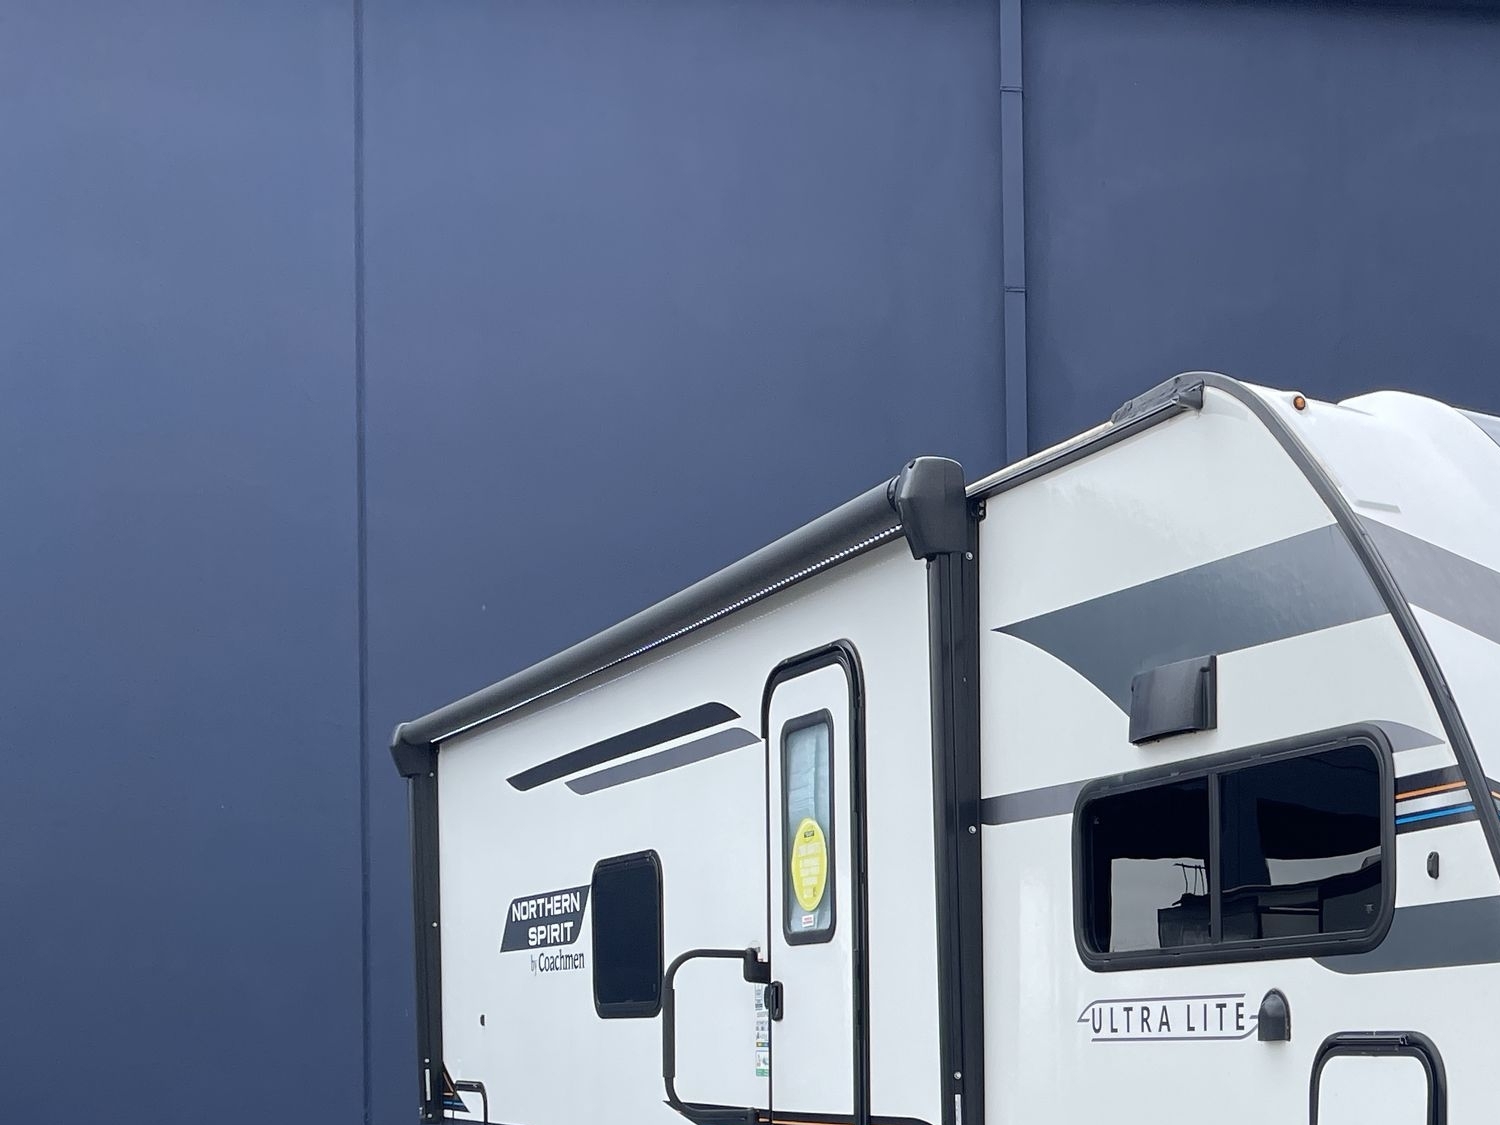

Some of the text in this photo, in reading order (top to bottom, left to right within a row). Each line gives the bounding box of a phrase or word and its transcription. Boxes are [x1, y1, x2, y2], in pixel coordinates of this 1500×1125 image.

[511, 891, 581, 922] NORTHERN
[528, 921, 574, 946] SPIRIT
[530, 949, 585, 976] by Coachmen
[1092, 1002, 1245, 1034] ULTRA LITE
